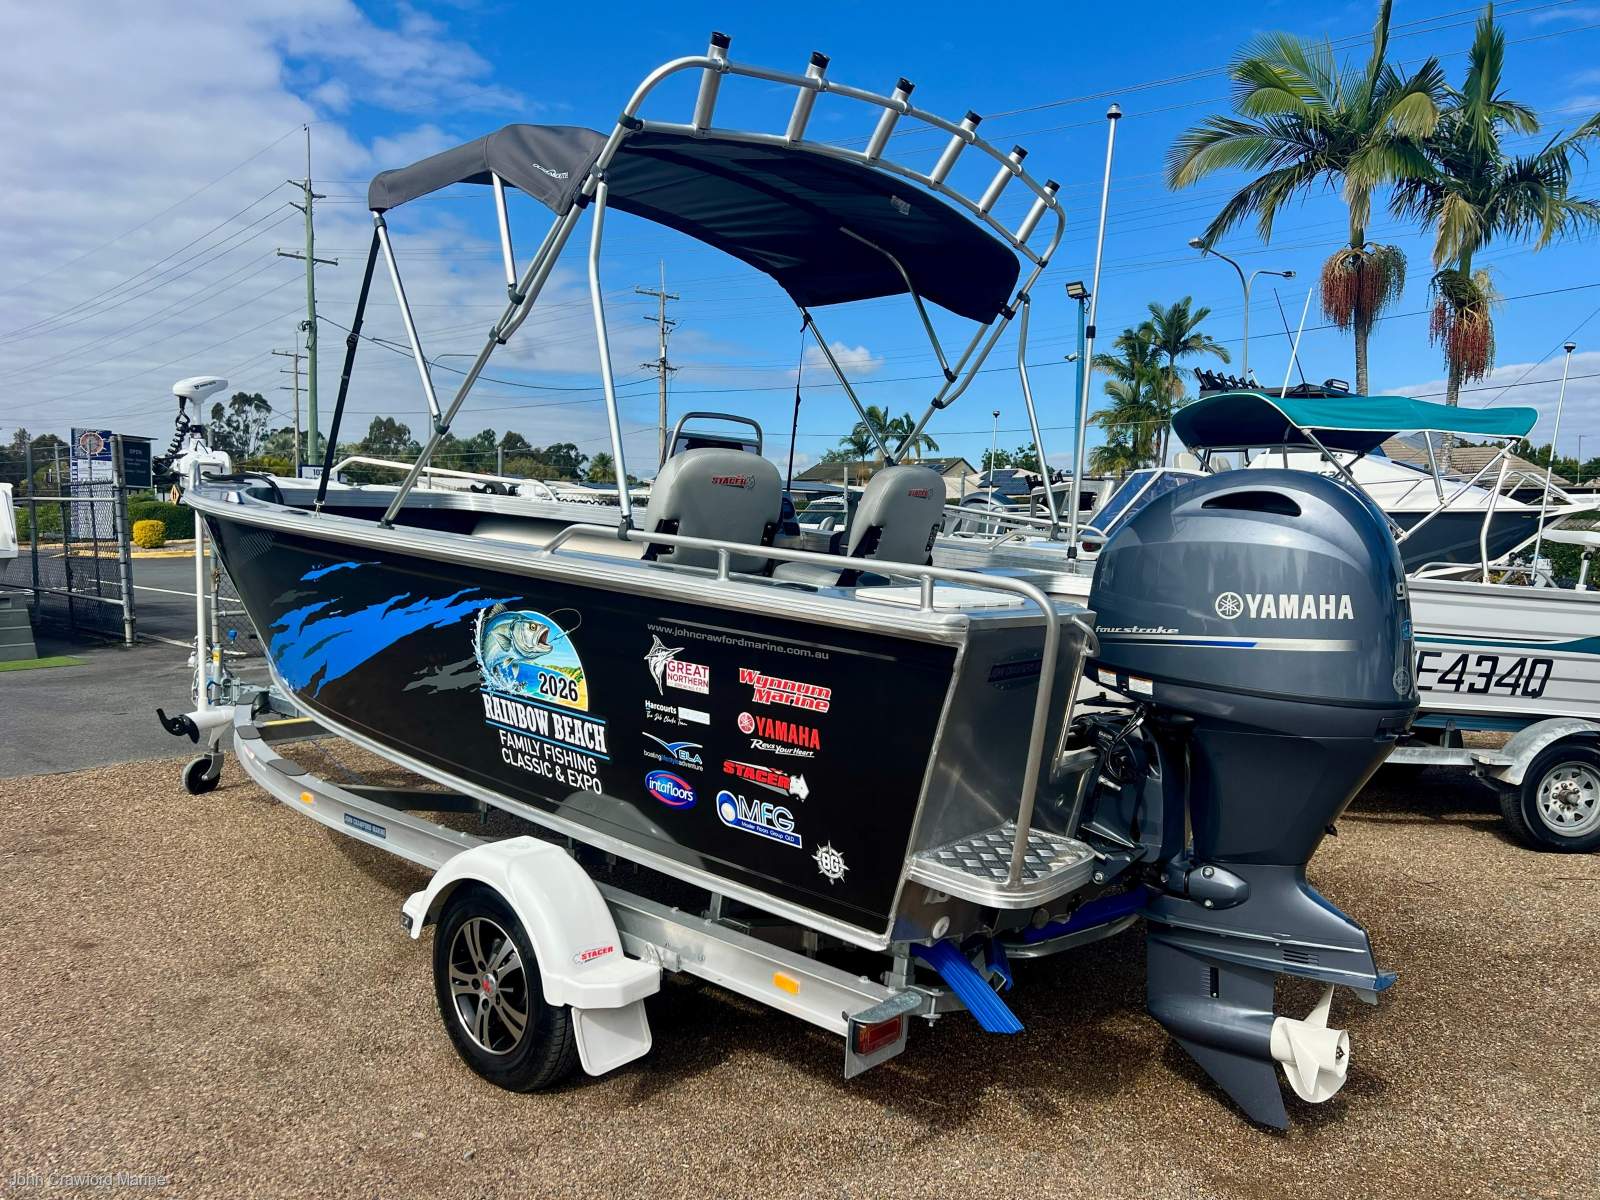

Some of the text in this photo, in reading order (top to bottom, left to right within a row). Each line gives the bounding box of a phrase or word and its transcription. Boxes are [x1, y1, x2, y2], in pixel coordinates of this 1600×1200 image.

[1245, 593, 1354, 620] YAMAHA
[647, 623, 830, 660] www.johncrawfordmarine.com.au
[667, 660, 709, 678] GREAT
[667, 673, 709, 688] NORTHERN
[538, 672, 578, 702] 2026
[739, 668, 831, 700] Wynnum
[645, 700, 677, 714] Harcourts
[752, 686, 830, 713] Marine
[482, 694, 607, 753] RAINBOW BEACH
[756, 715, 821, 750] YAMAHA
[499, 729, 597, 775] FAMILY FISHING
[678, 749, 703, 765] BLA
[750, 738, 815, 757] Revs Your Heart
[501, 747, 602, 794] CLASSIC & EXPO
[723, 760, 791, 790] STACER
[649, 777, 694, 801] intafloors
[738, 794, 795, 833] MFG
[821, 852, 840, 873] BG
[581, 946, 614, 960] STACER
